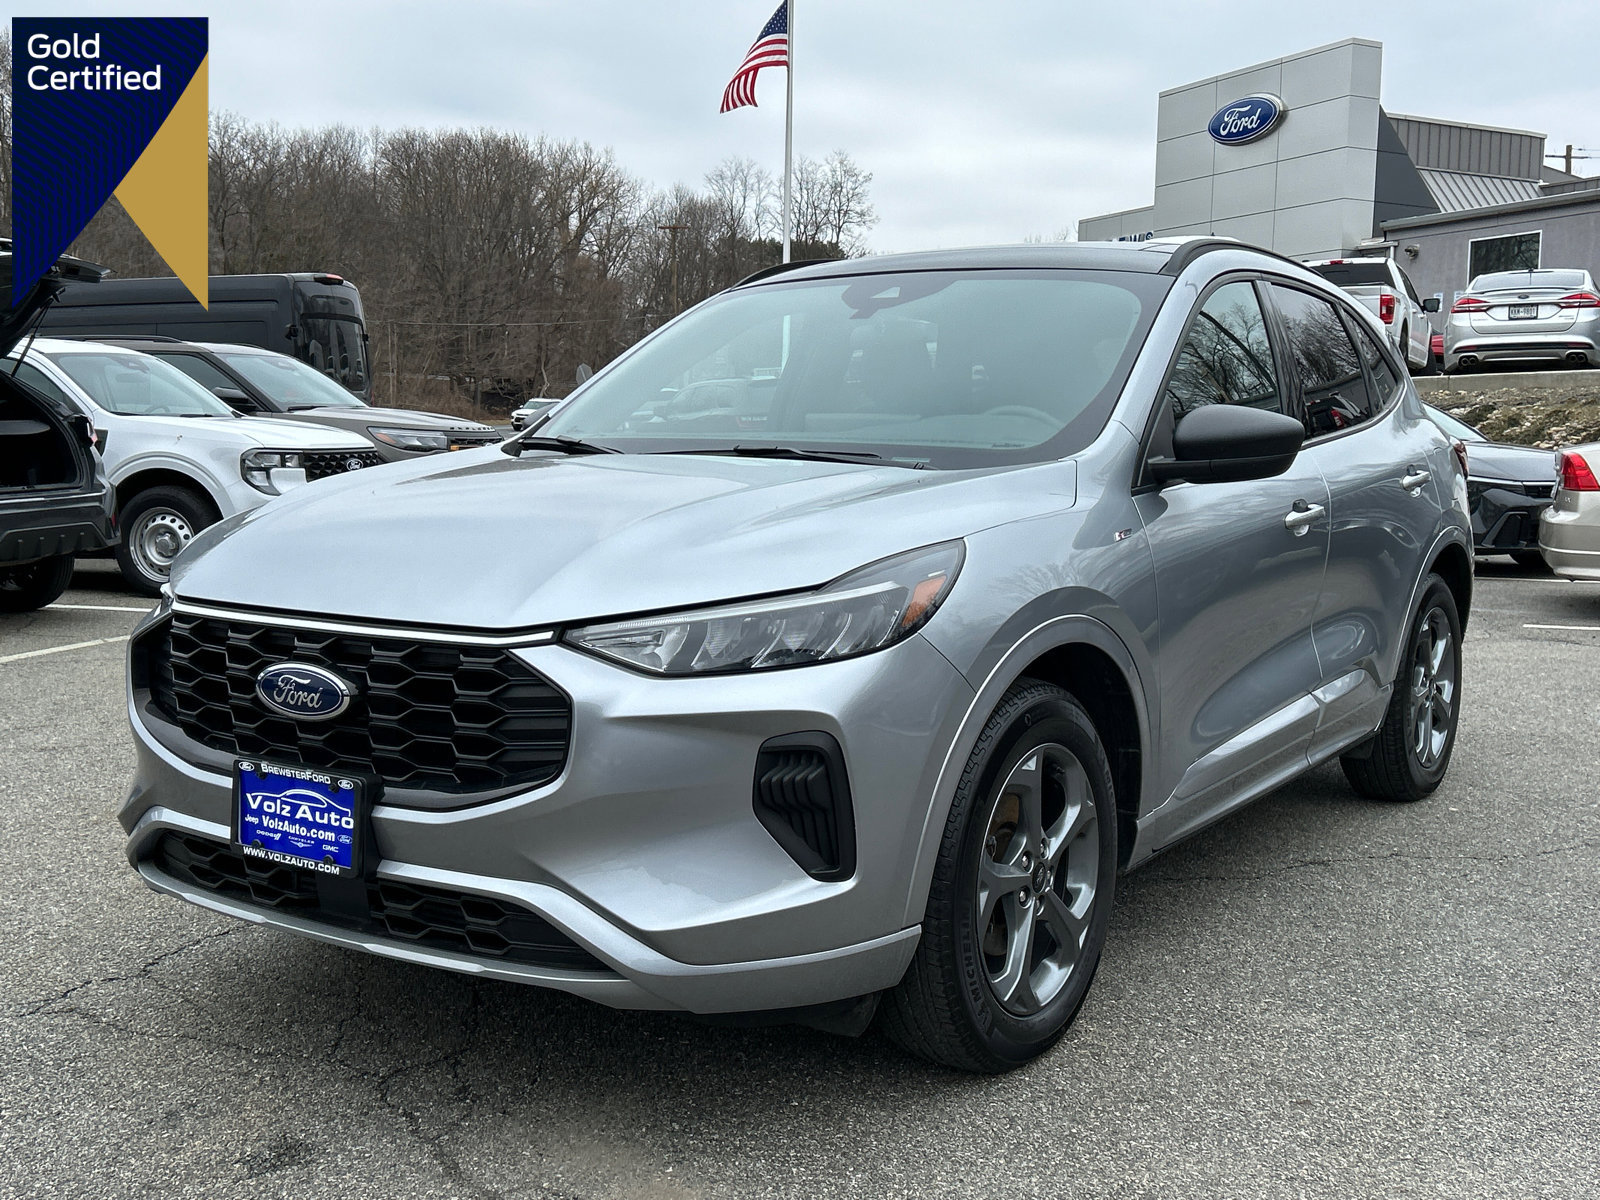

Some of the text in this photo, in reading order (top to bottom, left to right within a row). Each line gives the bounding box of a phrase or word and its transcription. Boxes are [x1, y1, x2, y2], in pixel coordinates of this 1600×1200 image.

[1219, 104, 1261, 136] Ford
[273, 675, 324, 709] Ford
[245, 814, 259, 825] Jeep
[246, 793, 354, 829] Volz Auto
[262, 815, 335, 842] VolzAuto.com
[243, 846, 340, 875] WWW.VOLZAUTO.COM
[322, 844, 339, 853] GMC
